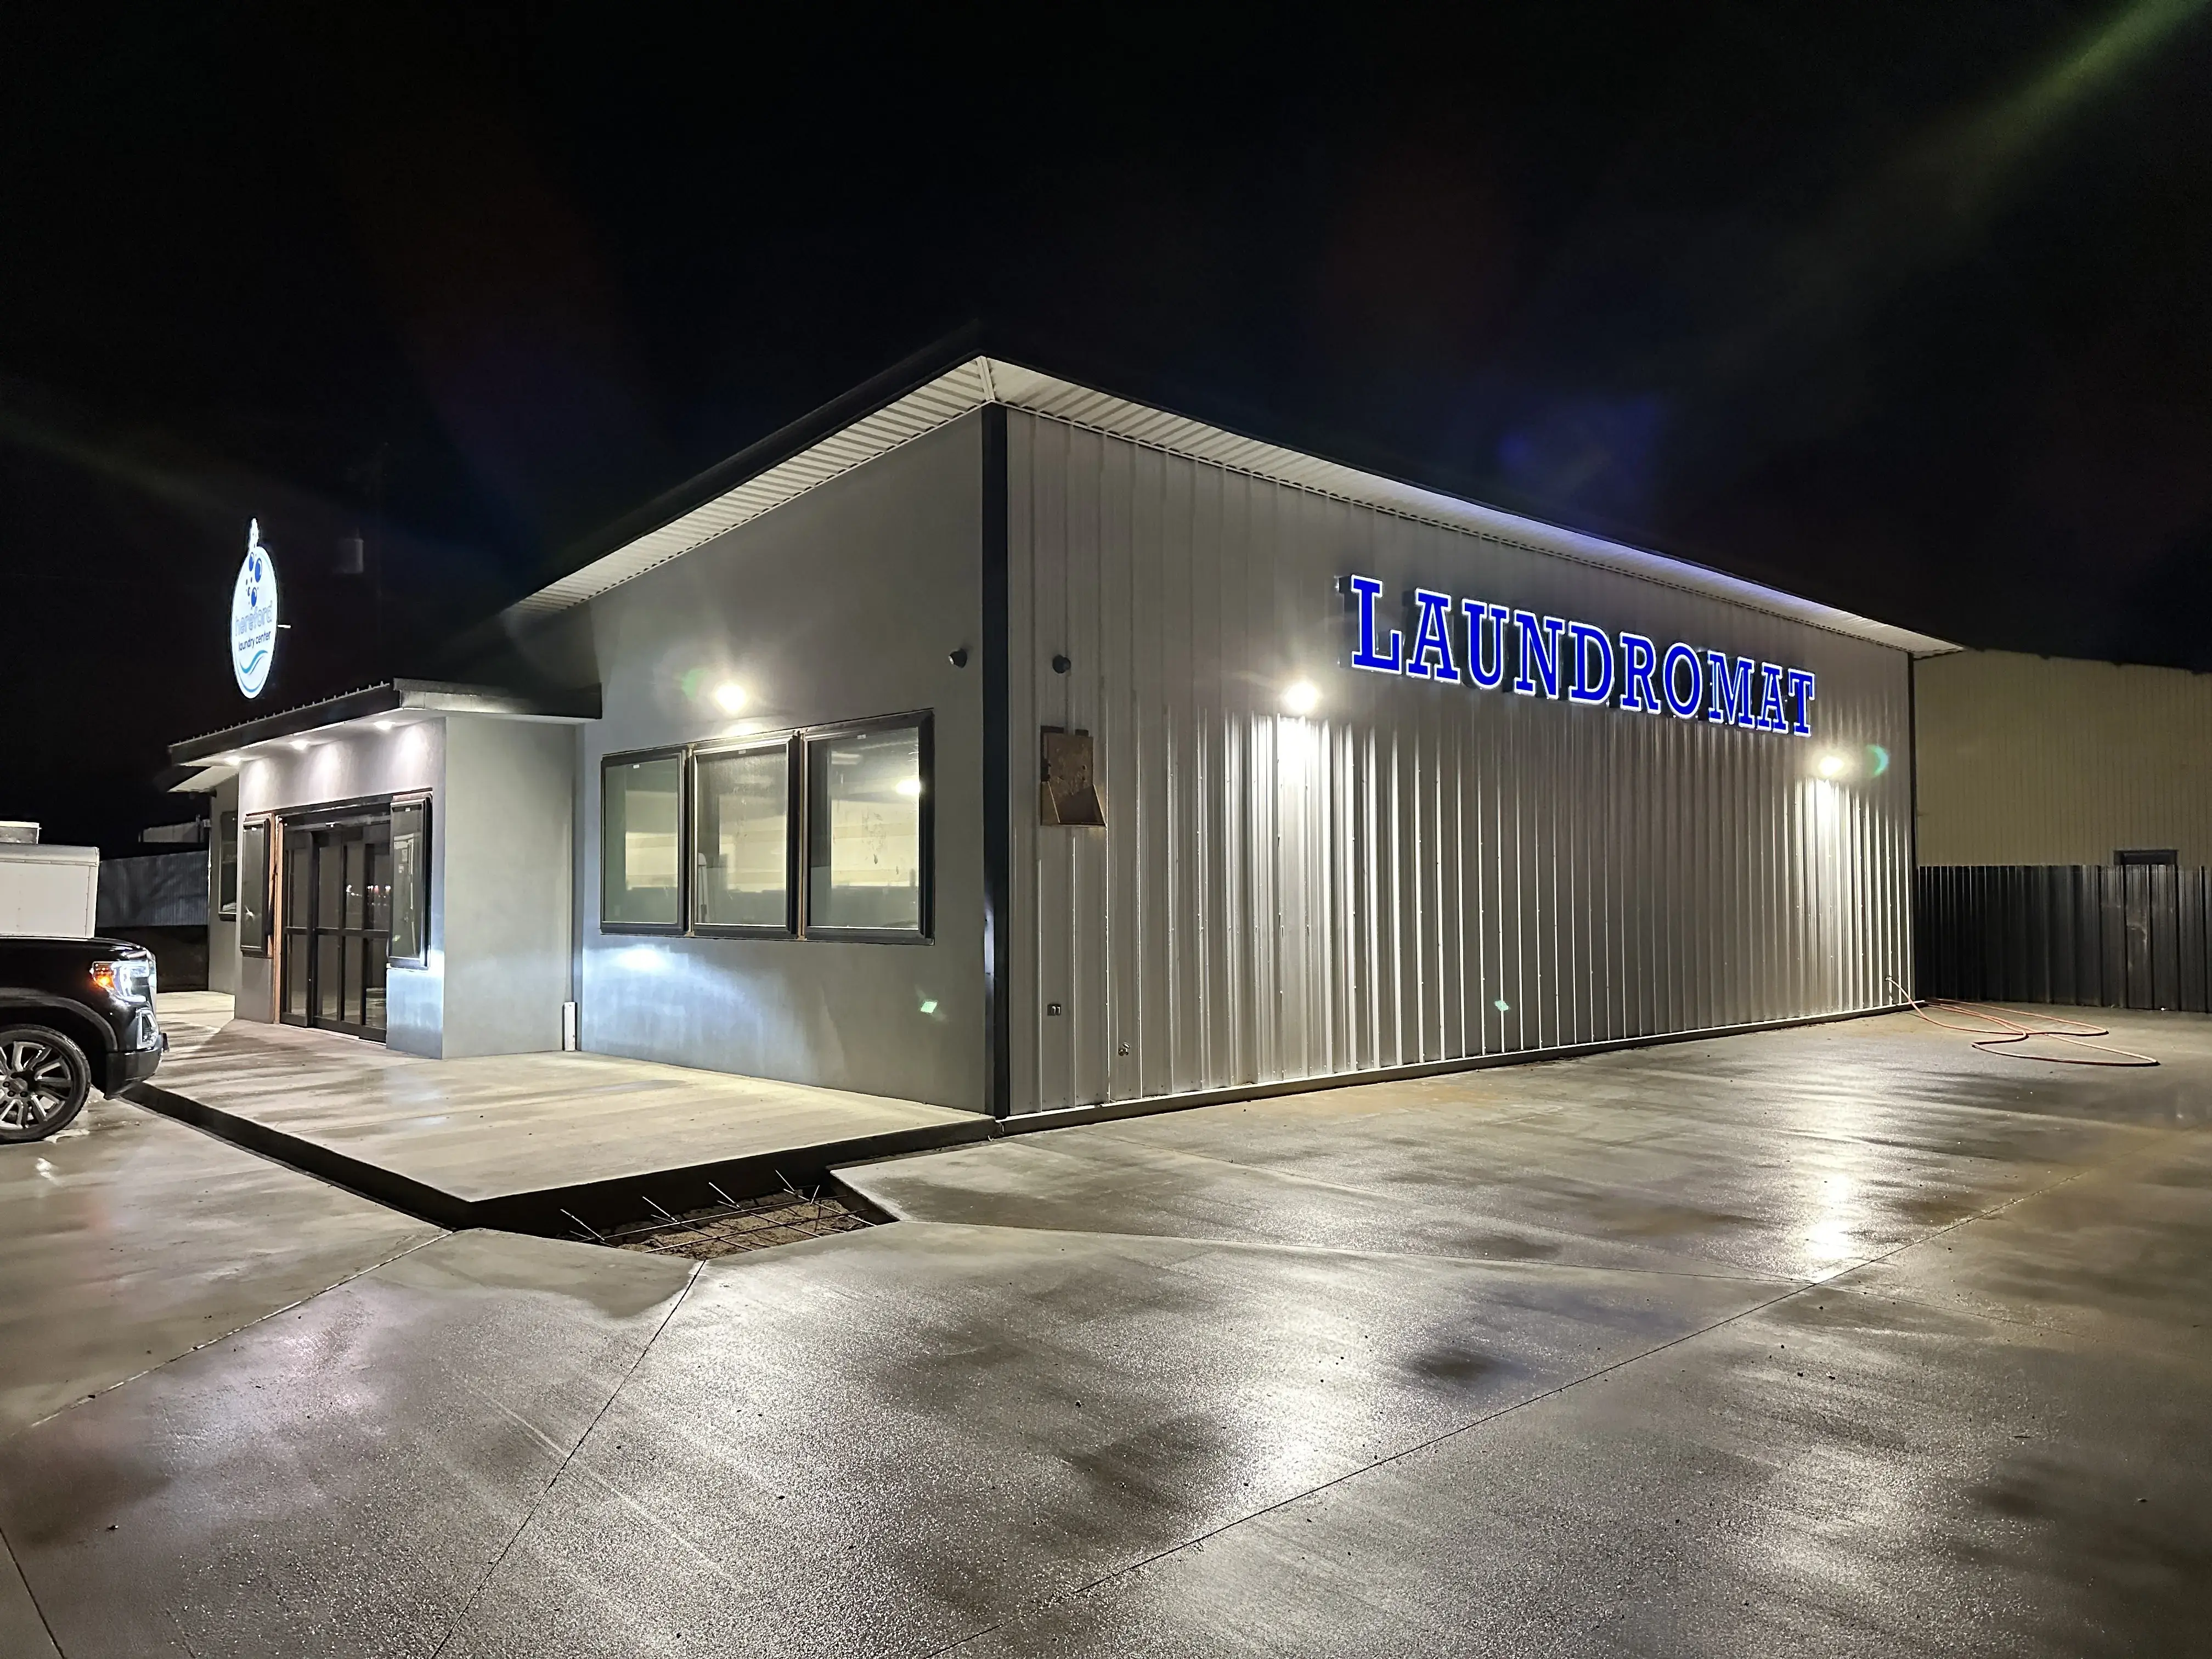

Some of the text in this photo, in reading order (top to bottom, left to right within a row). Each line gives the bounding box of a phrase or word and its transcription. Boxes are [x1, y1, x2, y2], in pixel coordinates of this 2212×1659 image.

[235, 601, 272, 636] hereford
[239, 631, 271, 651] laundry center
[1350, 574, 1815, 737] LAUNDROMAT
